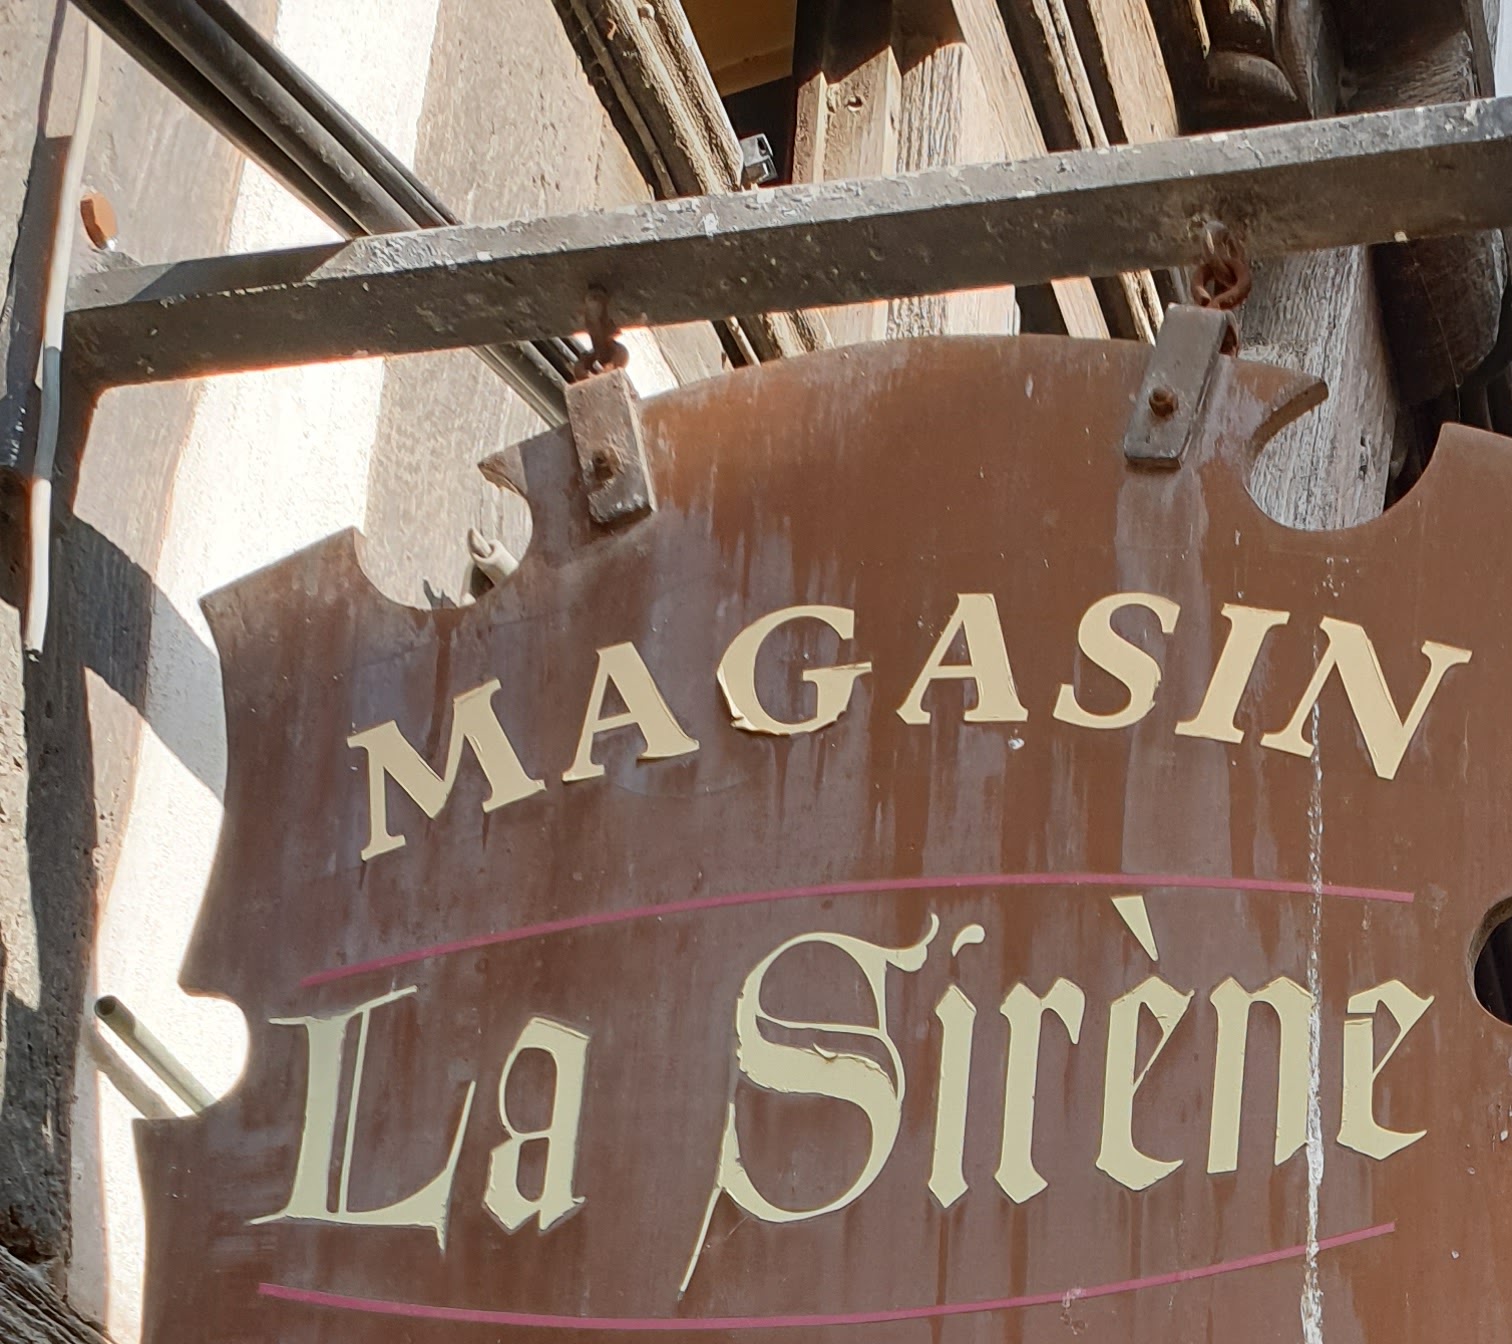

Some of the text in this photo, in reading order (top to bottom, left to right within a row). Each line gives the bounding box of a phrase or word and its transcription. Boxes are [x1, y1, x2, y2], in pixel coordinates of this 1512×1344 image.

[348, 593, 1472, 862] MAGASIN
[251, 894, 1436, 1300] La Sirène
